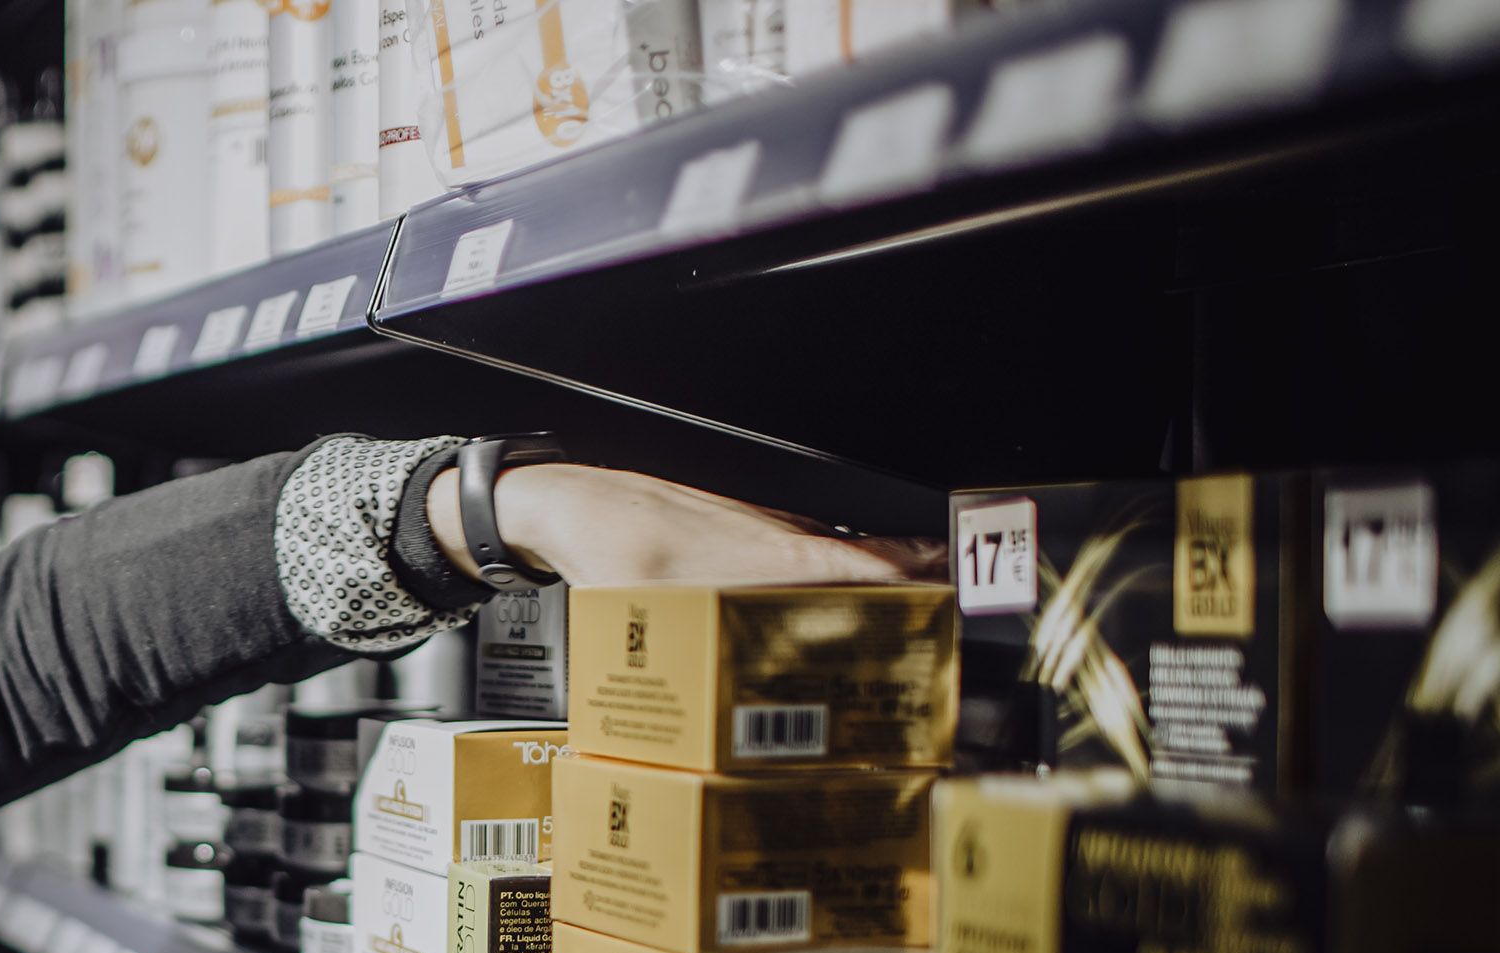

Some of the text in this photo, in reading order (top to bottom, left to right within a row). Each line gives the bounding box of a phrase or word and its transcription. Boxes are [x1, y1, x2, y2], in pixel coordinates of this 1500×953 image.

[965, 531, 1003, 586] 17
[496, 599, 541, 624] GOLD
[542, 816, 553, 834] 5
[500, 891, 514, 899] PT.
[515, 891, 534, 899] Ouro
[500, 908, 531, 916] Células
[500, 918, 531, 926] vegetais
[500, 934, 515, 942] FR.
[517, 934, 541, 943] Liquid
